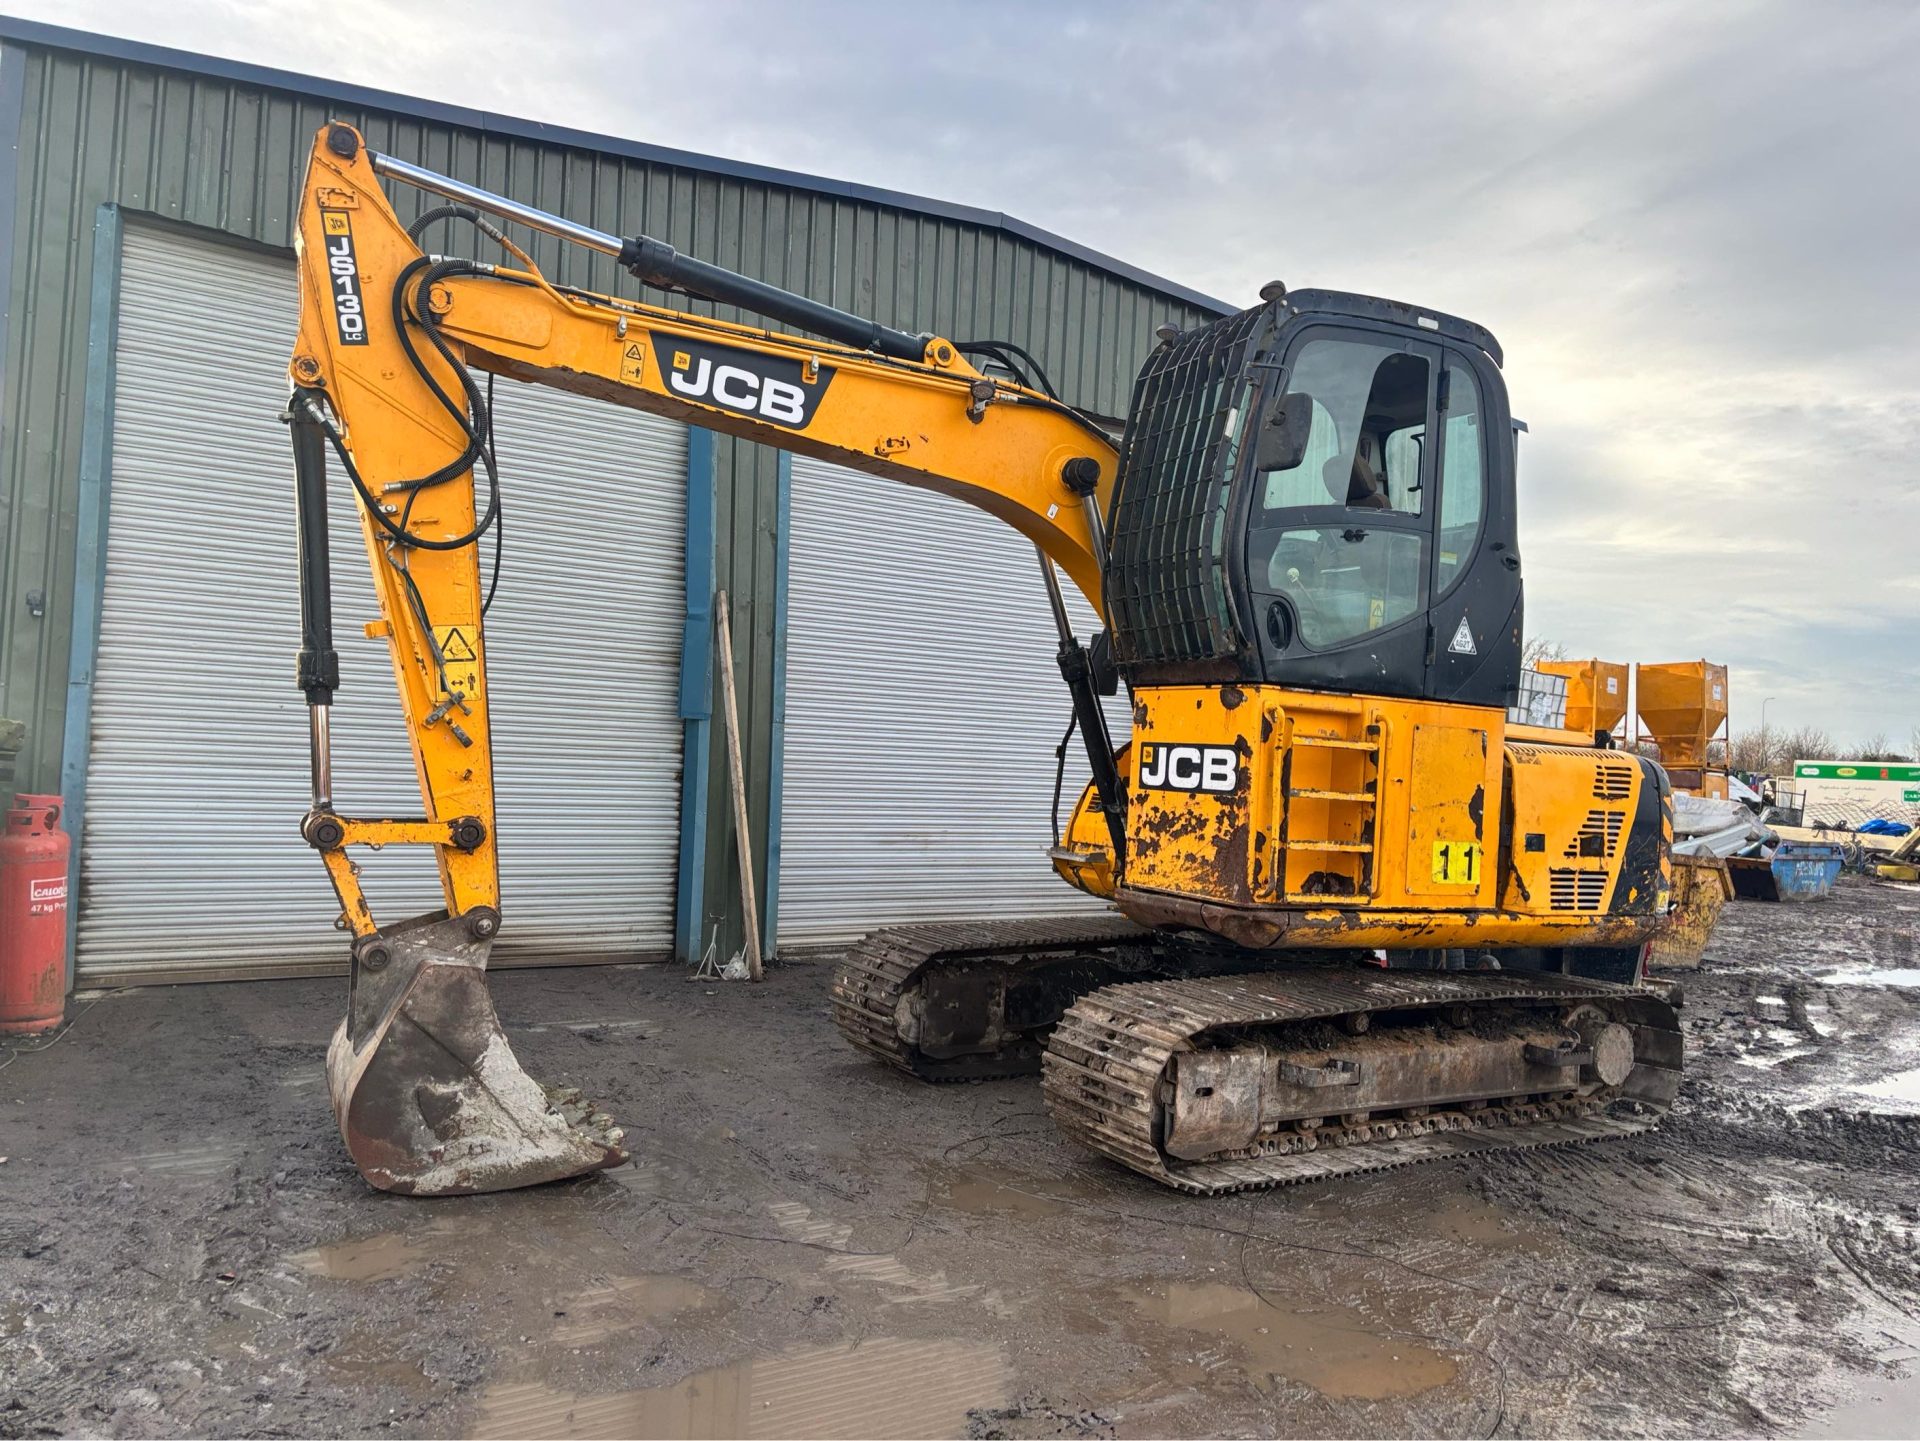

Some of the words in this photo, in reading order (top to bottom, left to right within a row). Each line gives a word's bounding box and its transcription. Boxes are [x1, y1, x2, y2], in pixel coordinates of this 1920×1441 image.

[330, 237, 363, 333] JS130
[345, 333, 362, 341] LC
[670, 357, 806, 424] JCB
[1141, 746, 1237, 791] JCB
[1439, 844, 1474, 881] 11
[31, 904, 42, 912] 47
[43, 903, 53, 912] kg
